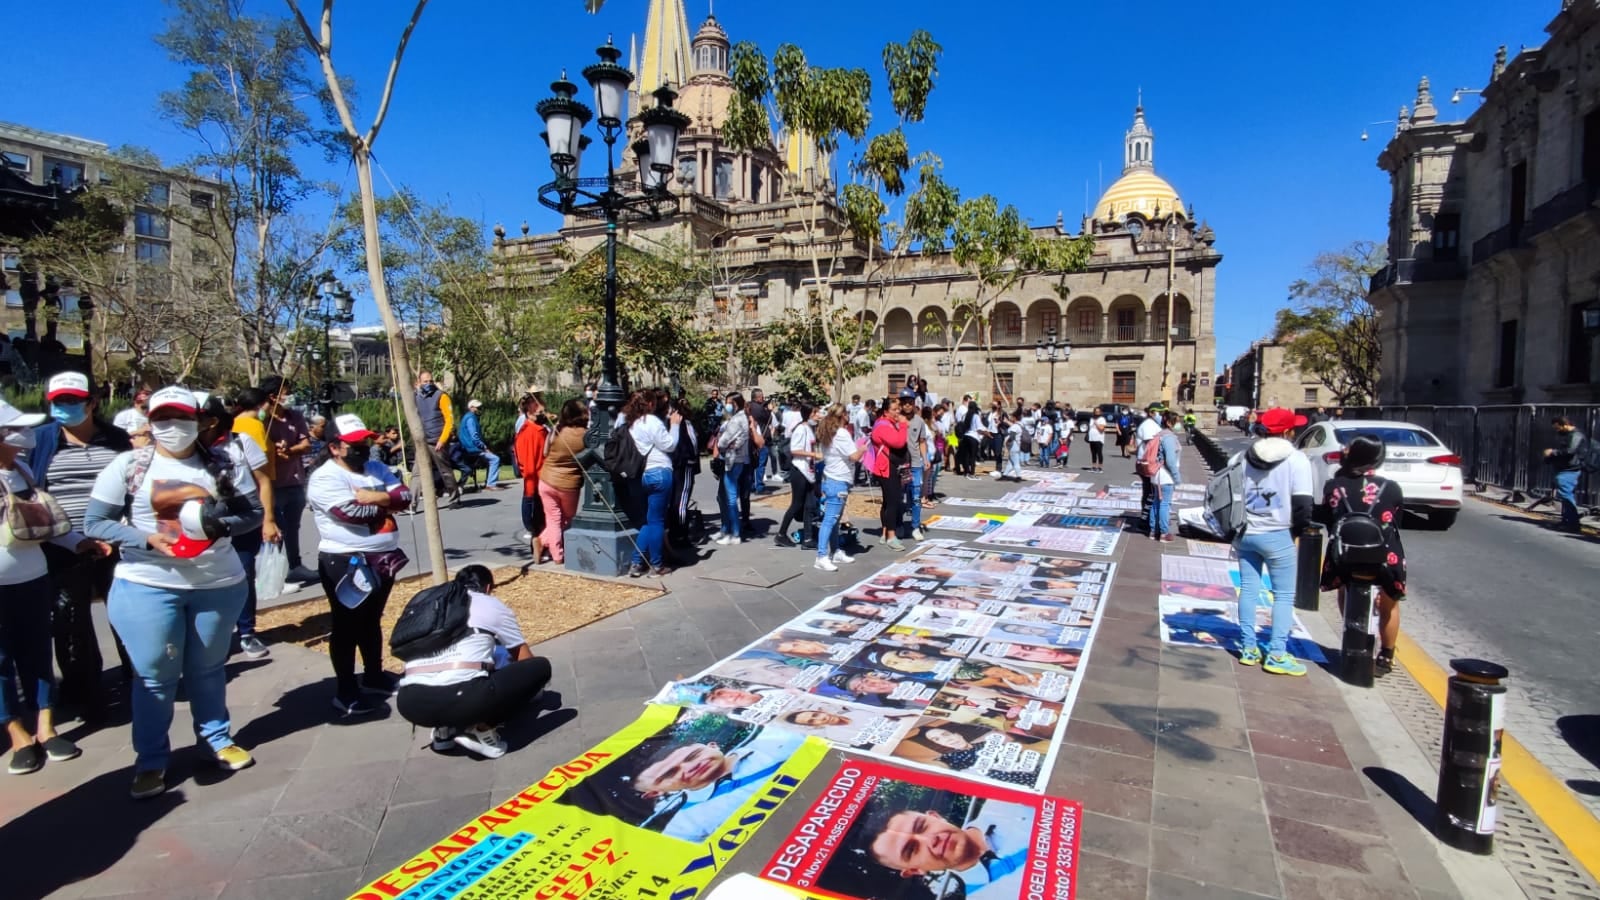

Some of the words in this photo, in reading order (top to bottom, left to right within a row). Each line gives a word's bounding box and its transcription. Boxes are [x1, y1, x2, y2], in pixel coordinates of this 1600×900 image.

[489, 836, 506, 847] A
[502, 850, 532, 871] DIA
[547, 823, 570, 838] DE
[538, 850, 561, 865] DE
[562, 826, 592, 848] LOS
[767, 767, 861, 881] DESAPARECIDO
[797, 878, 810, 888] 3
[854, 775, 877, 804] AGAVES
[1035, 797, 1056, 859] HERNÁNDEZ
[1056, 806, 1076, 869] 3331456314
